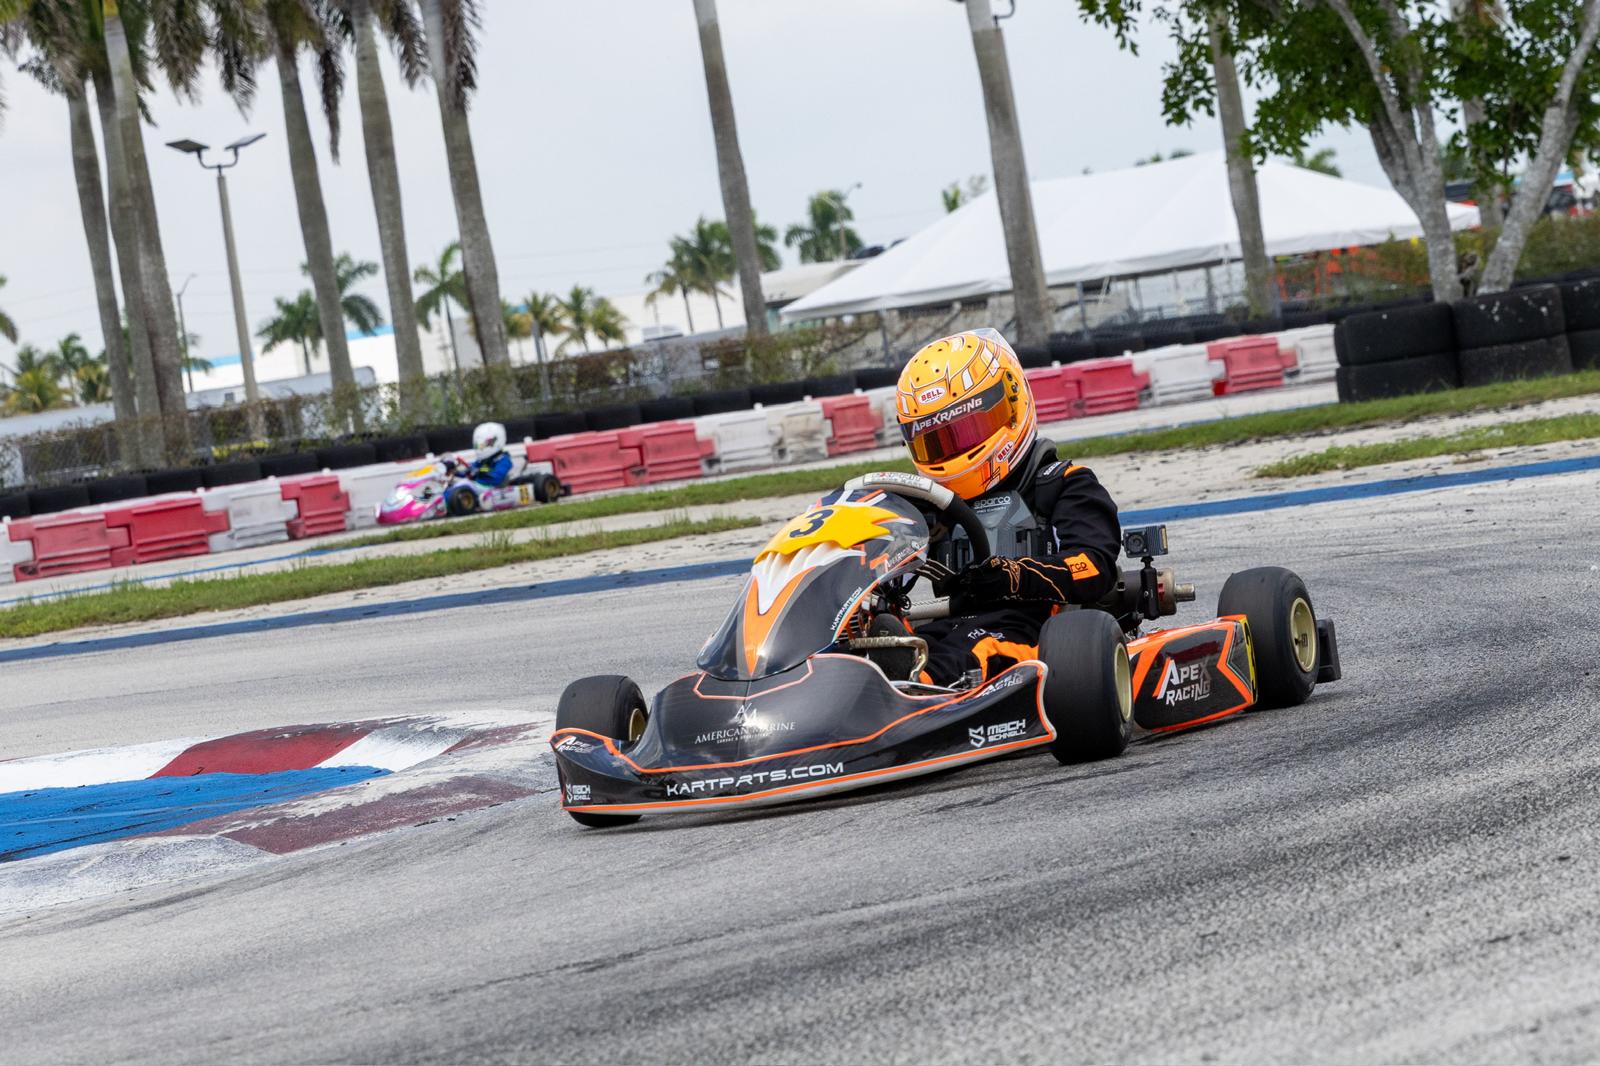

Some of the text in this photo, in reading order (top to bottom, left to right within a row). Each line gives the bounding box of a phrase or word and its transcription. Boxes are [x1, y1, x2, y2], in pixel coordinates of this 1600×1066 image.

[920, 388, 943, 401] BELL
[997, 443, 1014, 460] BELL
[789, 508, 834, 539] 3
[1156, 656, 1213, 700] APEX
[694, 726, 748, 745] AMERICAN
[666, 762, 844, 797] KARTPARTS.COM
